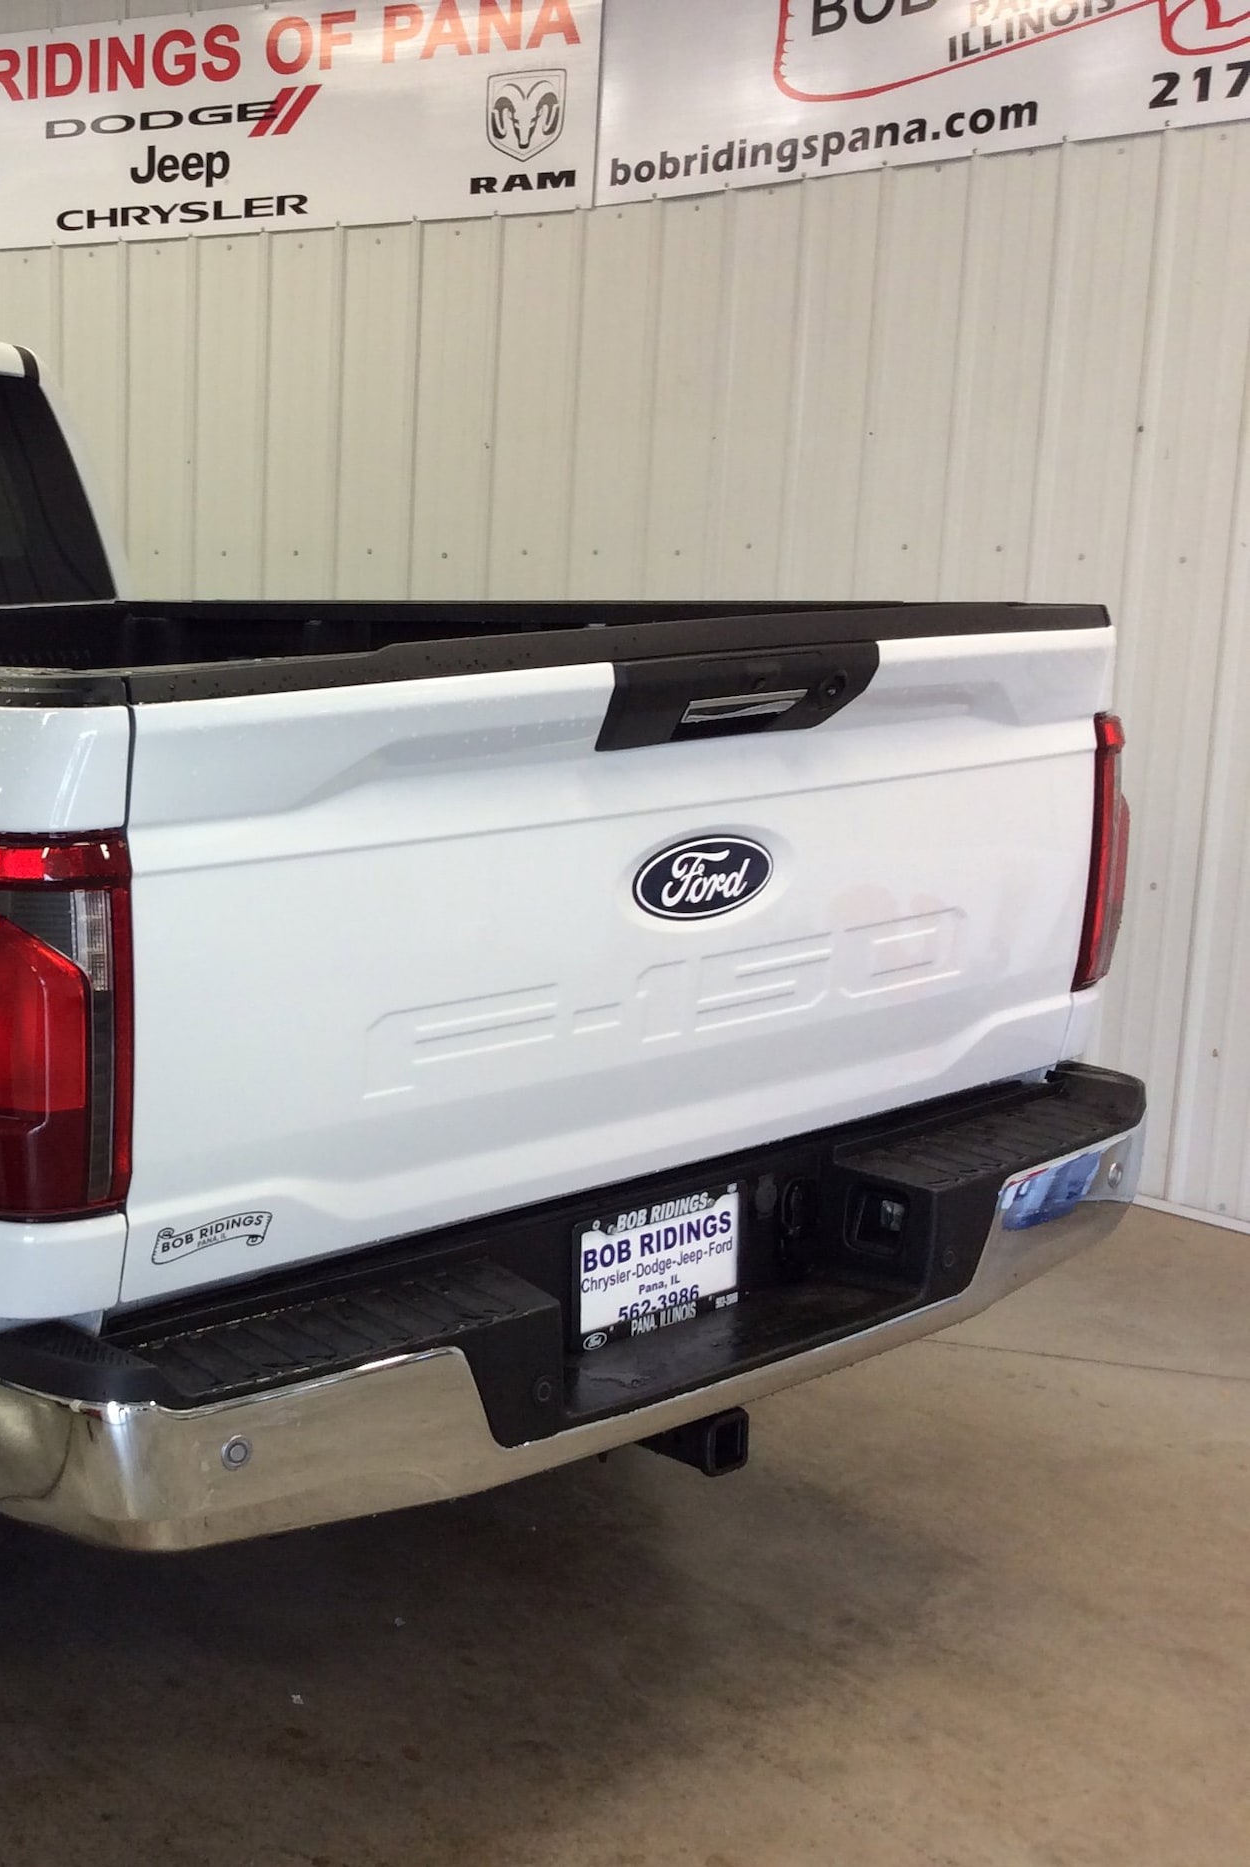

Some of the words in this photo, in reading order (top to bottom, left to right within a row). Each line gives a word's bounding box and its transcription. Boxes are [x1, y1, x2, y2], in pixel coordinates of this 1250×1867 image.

[266, 10, 356, 75] OF
[381, 0, 582, 63] PANA
[1149, 59, 1250, 109] 217
[46, 101, 278, 139] DODGE
[609, 100, 1038, 186] bobridingspana.com
[130, 146, 230, 188] Jeep
[470, 170, 577, 195] RAM
[57, 194, 308, 231] CHRYSLER
[661, 849, 750, 907] Ford
[363, 907, 967, 1099] F-150
[617, 1209, 647, 1232] BOB
[650, 1192, 709, 1223] RIDINGS
[162, 1233, 194, 1253] BOB
[200, 1215, 263, 1239] RIDINGS
[583, 1239, 631, 1273] BOB
[640, 1211, 731, 1257] RIDINGS
[581, 1237, 732, 1293] Chrysler-Dodge-Jeep-Ford
[639, 1280, 668, 1295] Pana,
[671, 1275, 680, 1286] IL
[618, 1285, 699, 1322] 562-3986
[660, 1302, 697, 1328] ILLINOIS
